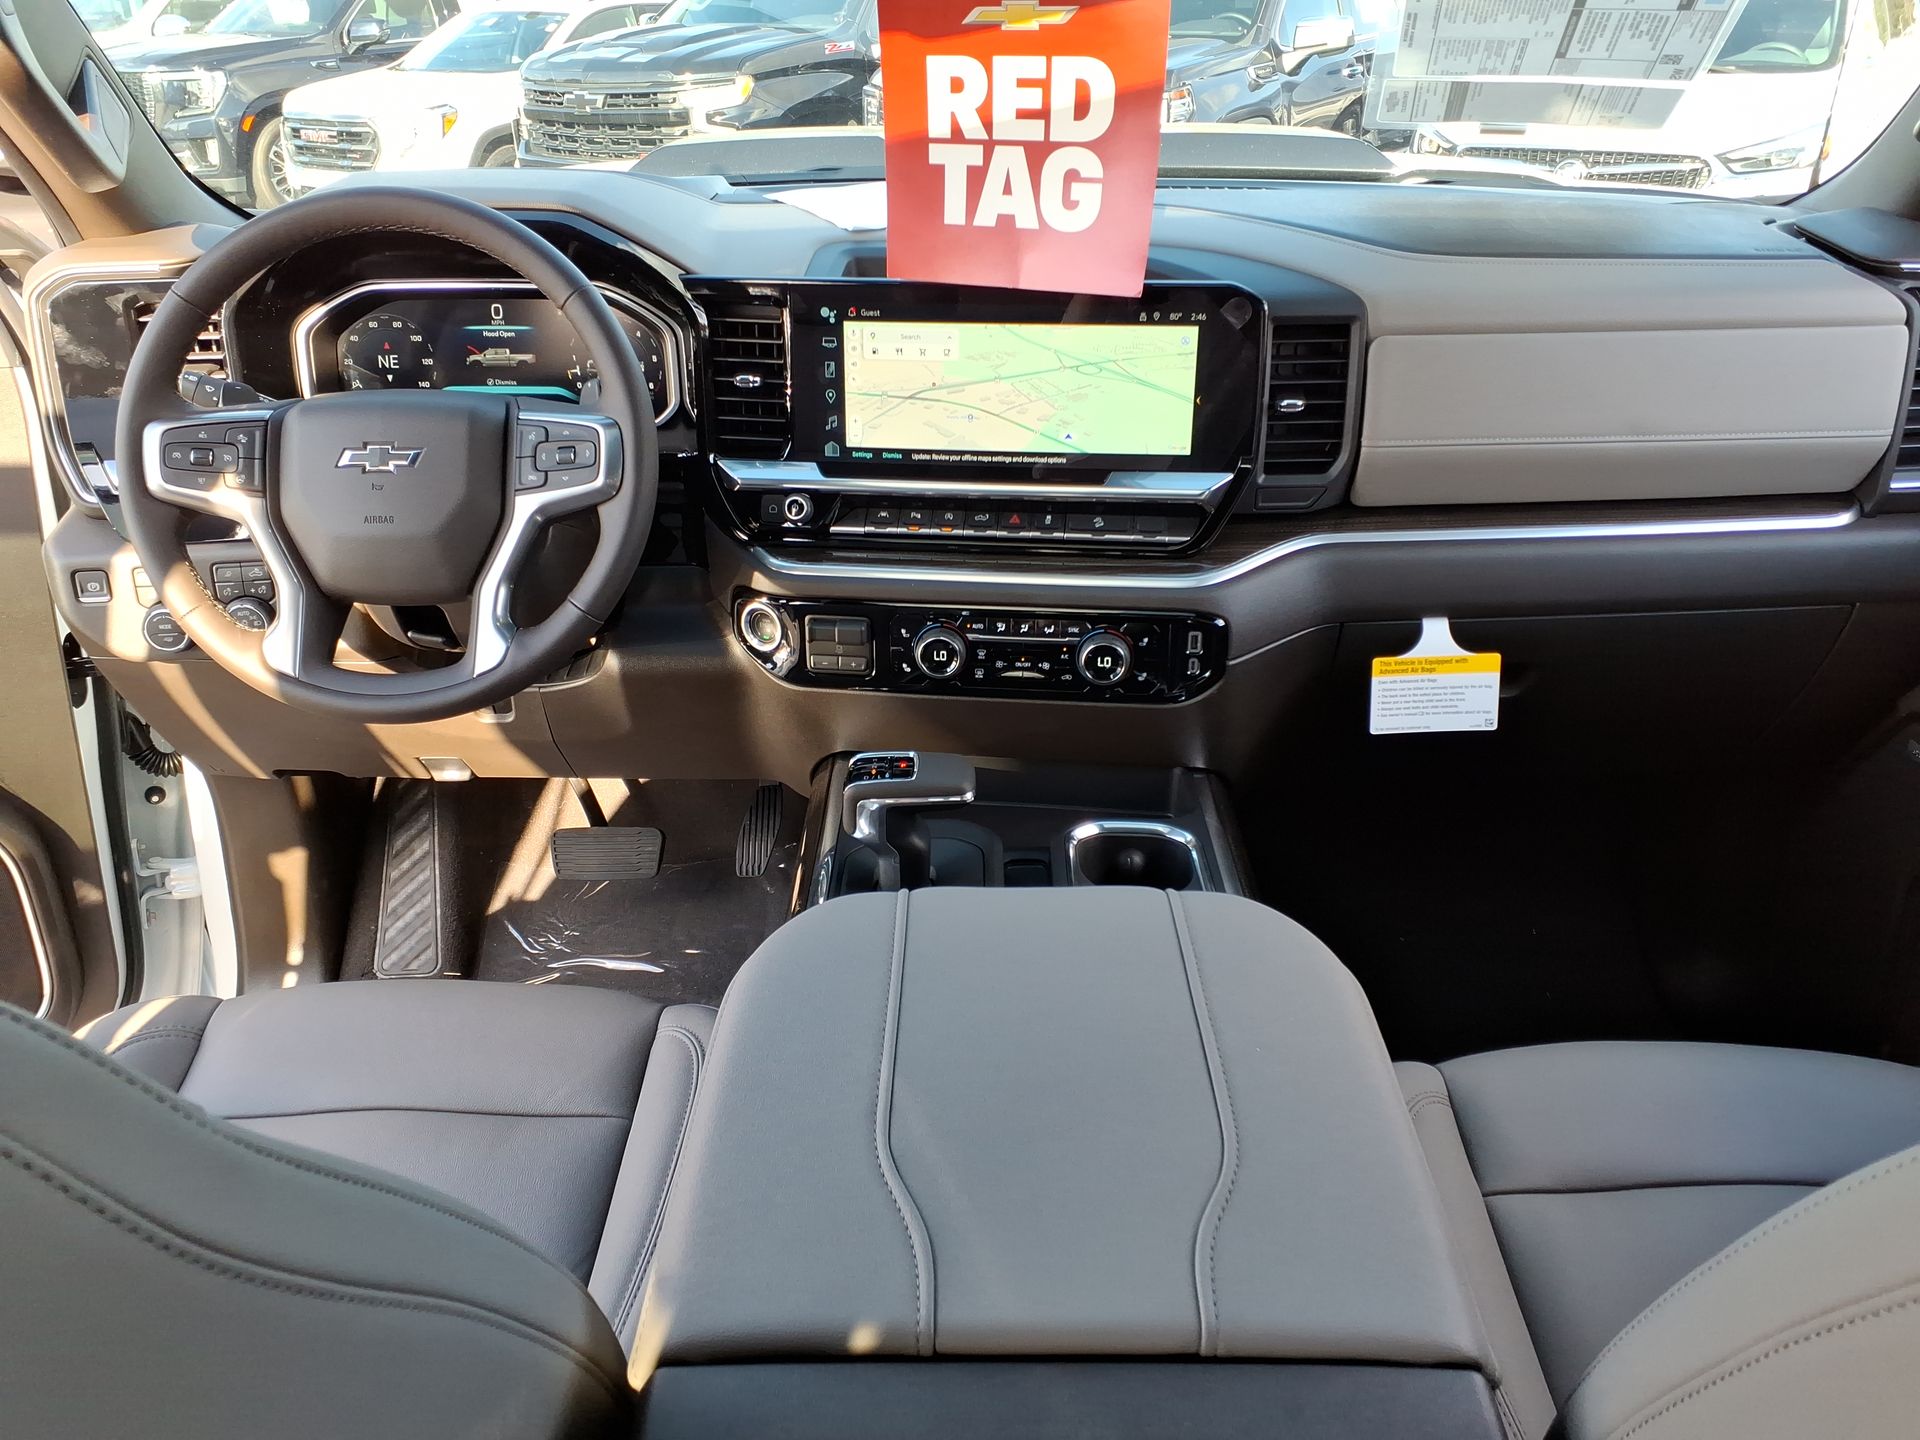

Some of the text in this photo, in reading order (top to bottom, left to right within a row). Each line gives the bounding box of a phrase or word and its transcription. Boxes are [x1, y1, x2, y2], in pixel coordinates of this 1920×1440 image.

[926, 55, 1116, 142] RED
[928, 143, 1104, 233] TAG
[491, 304, 503, 319] 0
[860, 308, 880, 317] Guest
[378, 355, 400, 369] NE
[852, 451, 873, 459] Settings
[364, 515, 395, 524] AIRBAG
